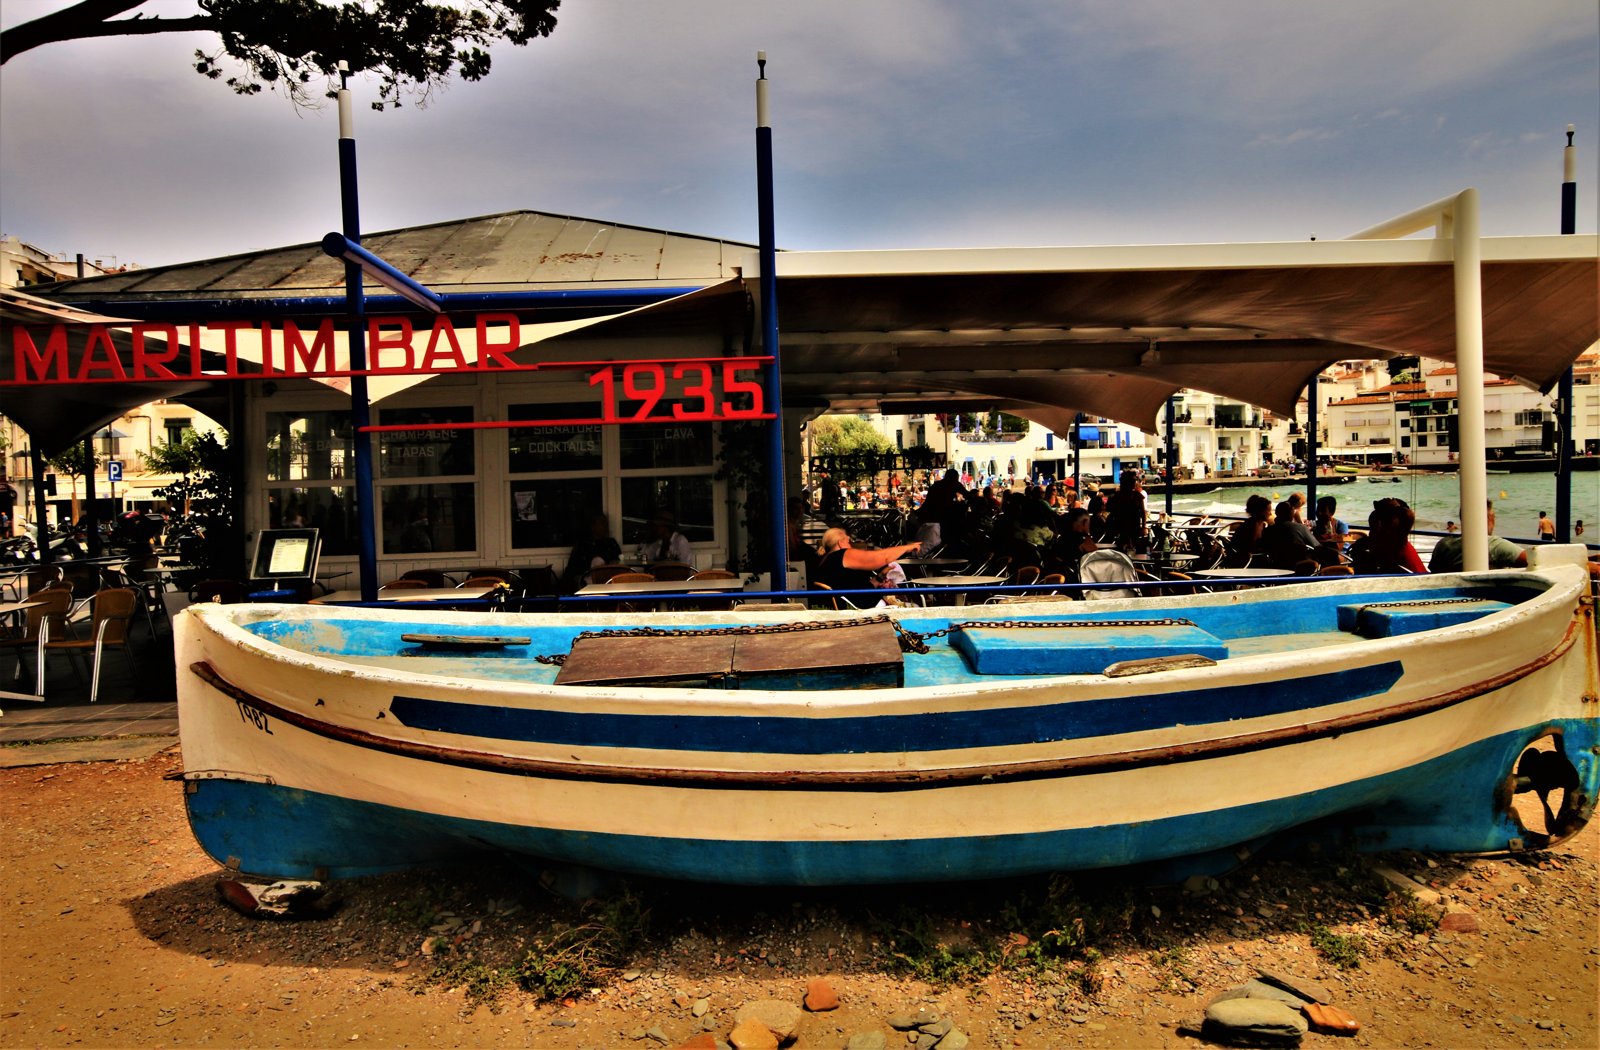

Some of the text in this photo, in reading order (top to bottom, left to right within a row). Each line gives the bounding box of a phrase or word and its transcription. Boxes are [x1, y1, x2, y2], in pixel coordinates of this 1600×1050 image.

[13, 312, 521, 383] MARITIM BAR
[589, 361, 764, 422] 1935
[381, 429, 459, 441] CHAMPAGNE
[533, 424, 602, 435] SIGNATURE
[664, 428, 695, 440] CAVA
[396, 446, 435, 458] TAPAS
[528, 440, 595, 454] COCKTAILS
[110, 463, 120, 480] P
[236, 699, 274, 736] 1982
